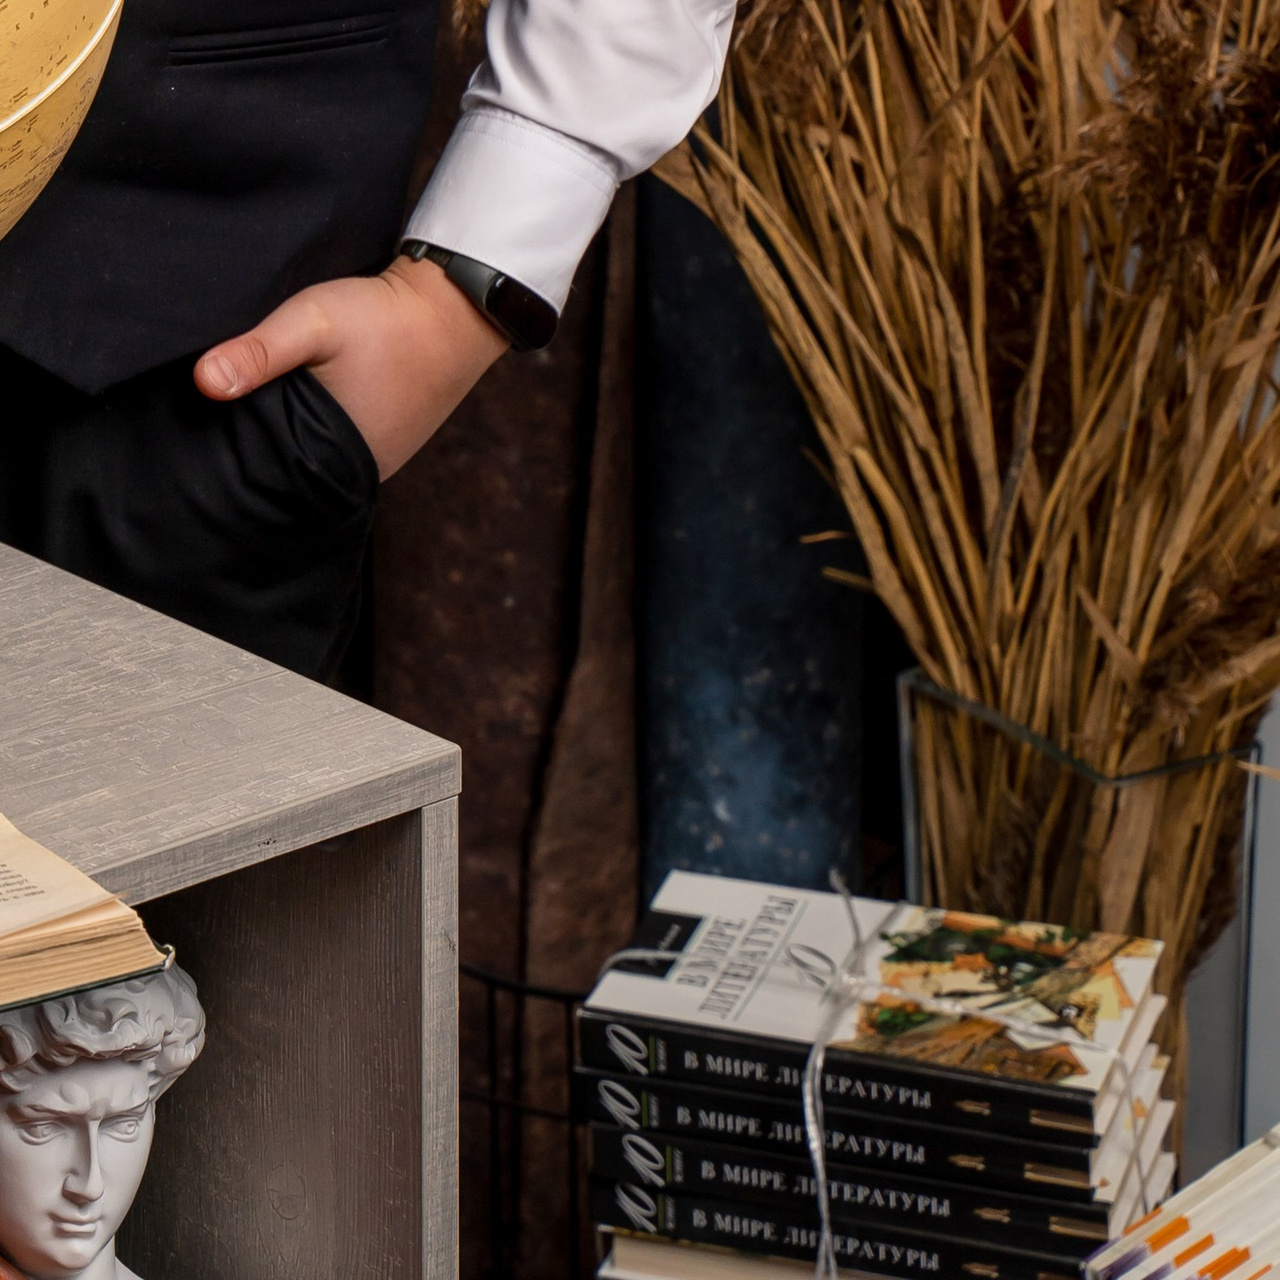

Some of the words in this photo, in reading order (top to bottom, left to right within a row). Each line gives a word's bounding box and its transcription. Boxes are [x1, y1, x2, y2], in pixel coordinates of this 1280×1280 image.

[685, 916, 746, 972] МИРЕ
[698, 895, 801, 1020] ЛИТЕРАТУРЫ
[605, 1024, 650, 1077] 10
[598, 1079, 642, 1131] 10
[683, 1051, 700, 1070] В
[705, 1054, 770, 1083] МИРЕ
[774, 1064, 933, 1110] ЛИЕРАТУРЫ
[676, 1106, 693, 1125] В
[698, 1109, 763, 1138] МИРЕ
[621, 1133, 666, 1188] 10
[700, 1160, 717, 1180] В
[722, 1162, 788, 1192] МИРЕ
[614, 1182, 658, 1234] 10
[691, 1208, 708, 1228] В
[714, 1211, 778, 1242] МИРЕ
[783, 1224, 941, 1272] ЛИЕРАТУРЫ
